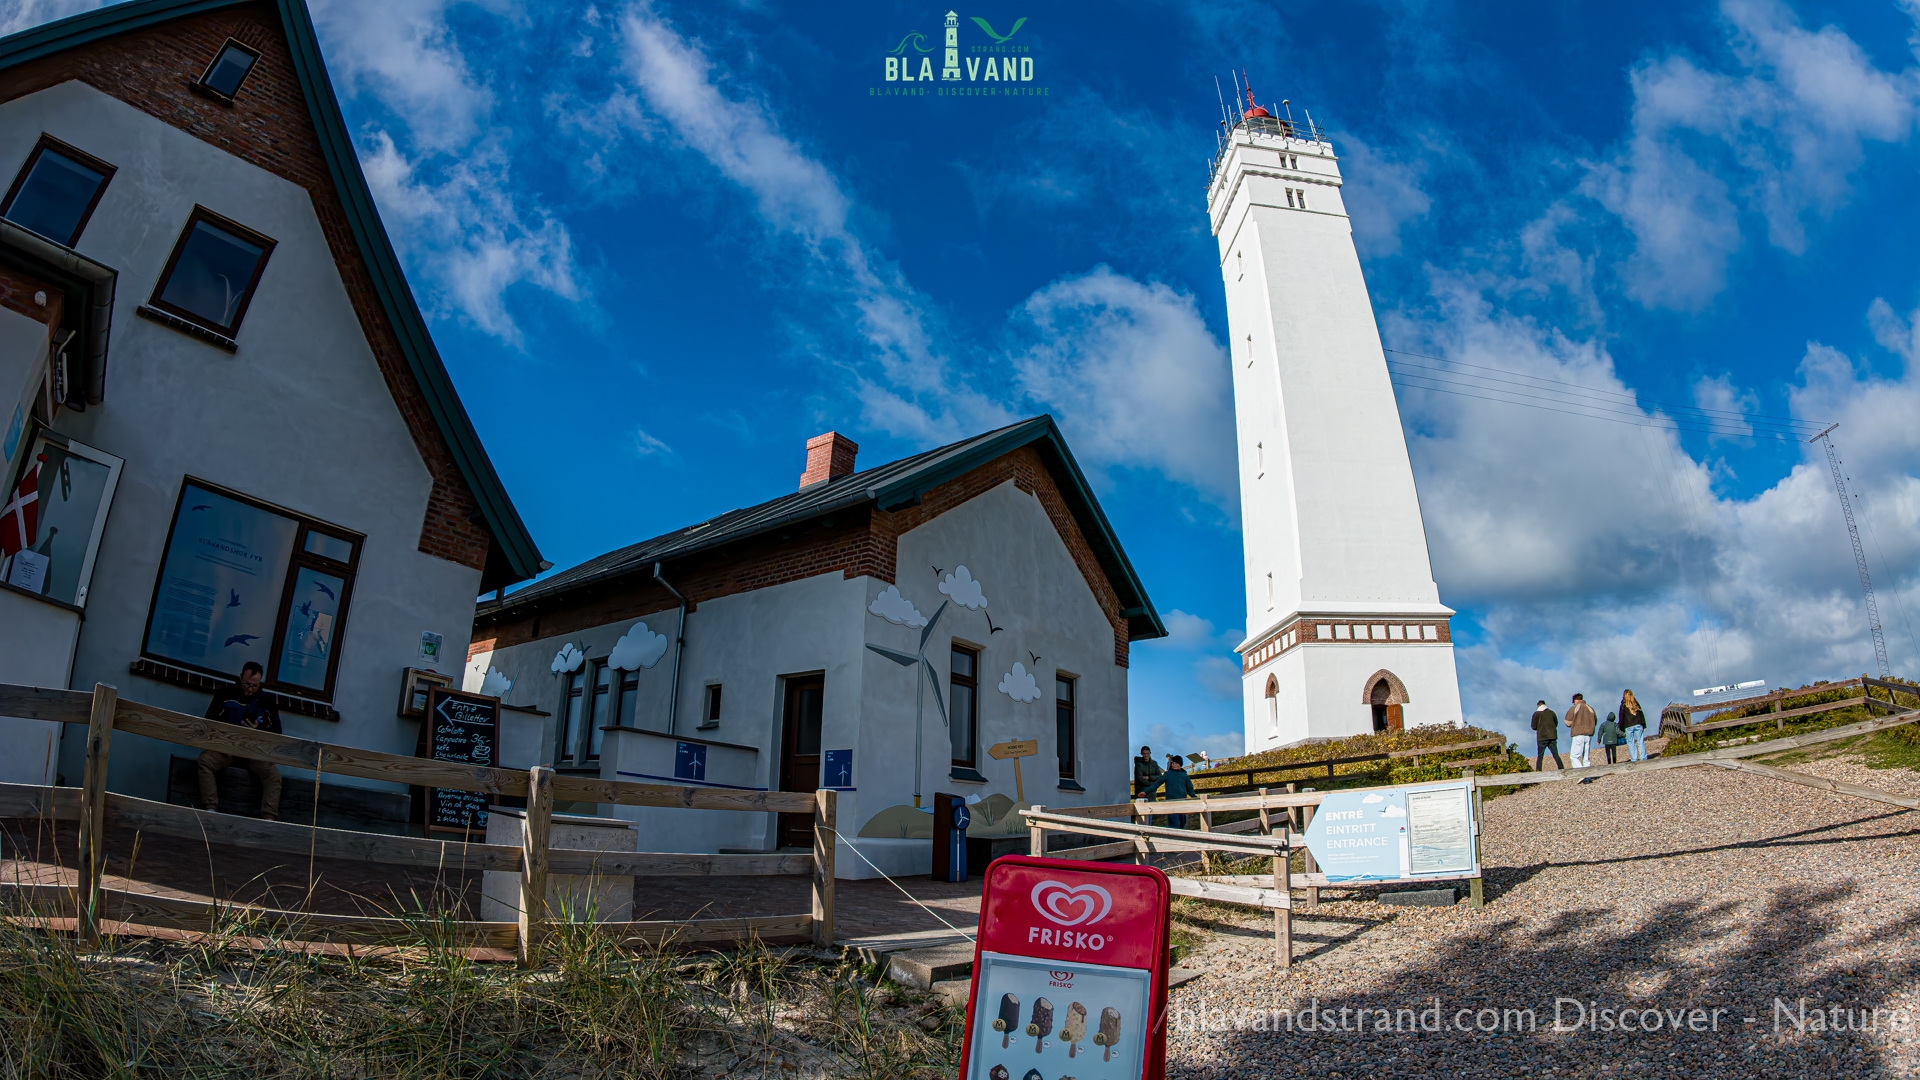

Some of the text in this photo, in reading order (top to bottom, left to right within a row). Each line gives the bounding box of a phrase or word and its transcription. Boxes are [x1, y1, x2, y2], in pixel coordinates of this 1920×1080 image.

[1325, 807, 1364, 822] ENTRÉ
[1326, 823, 1377, 836] EINTRITT
[1326, 836, 1389, 849] ENTRANCE
